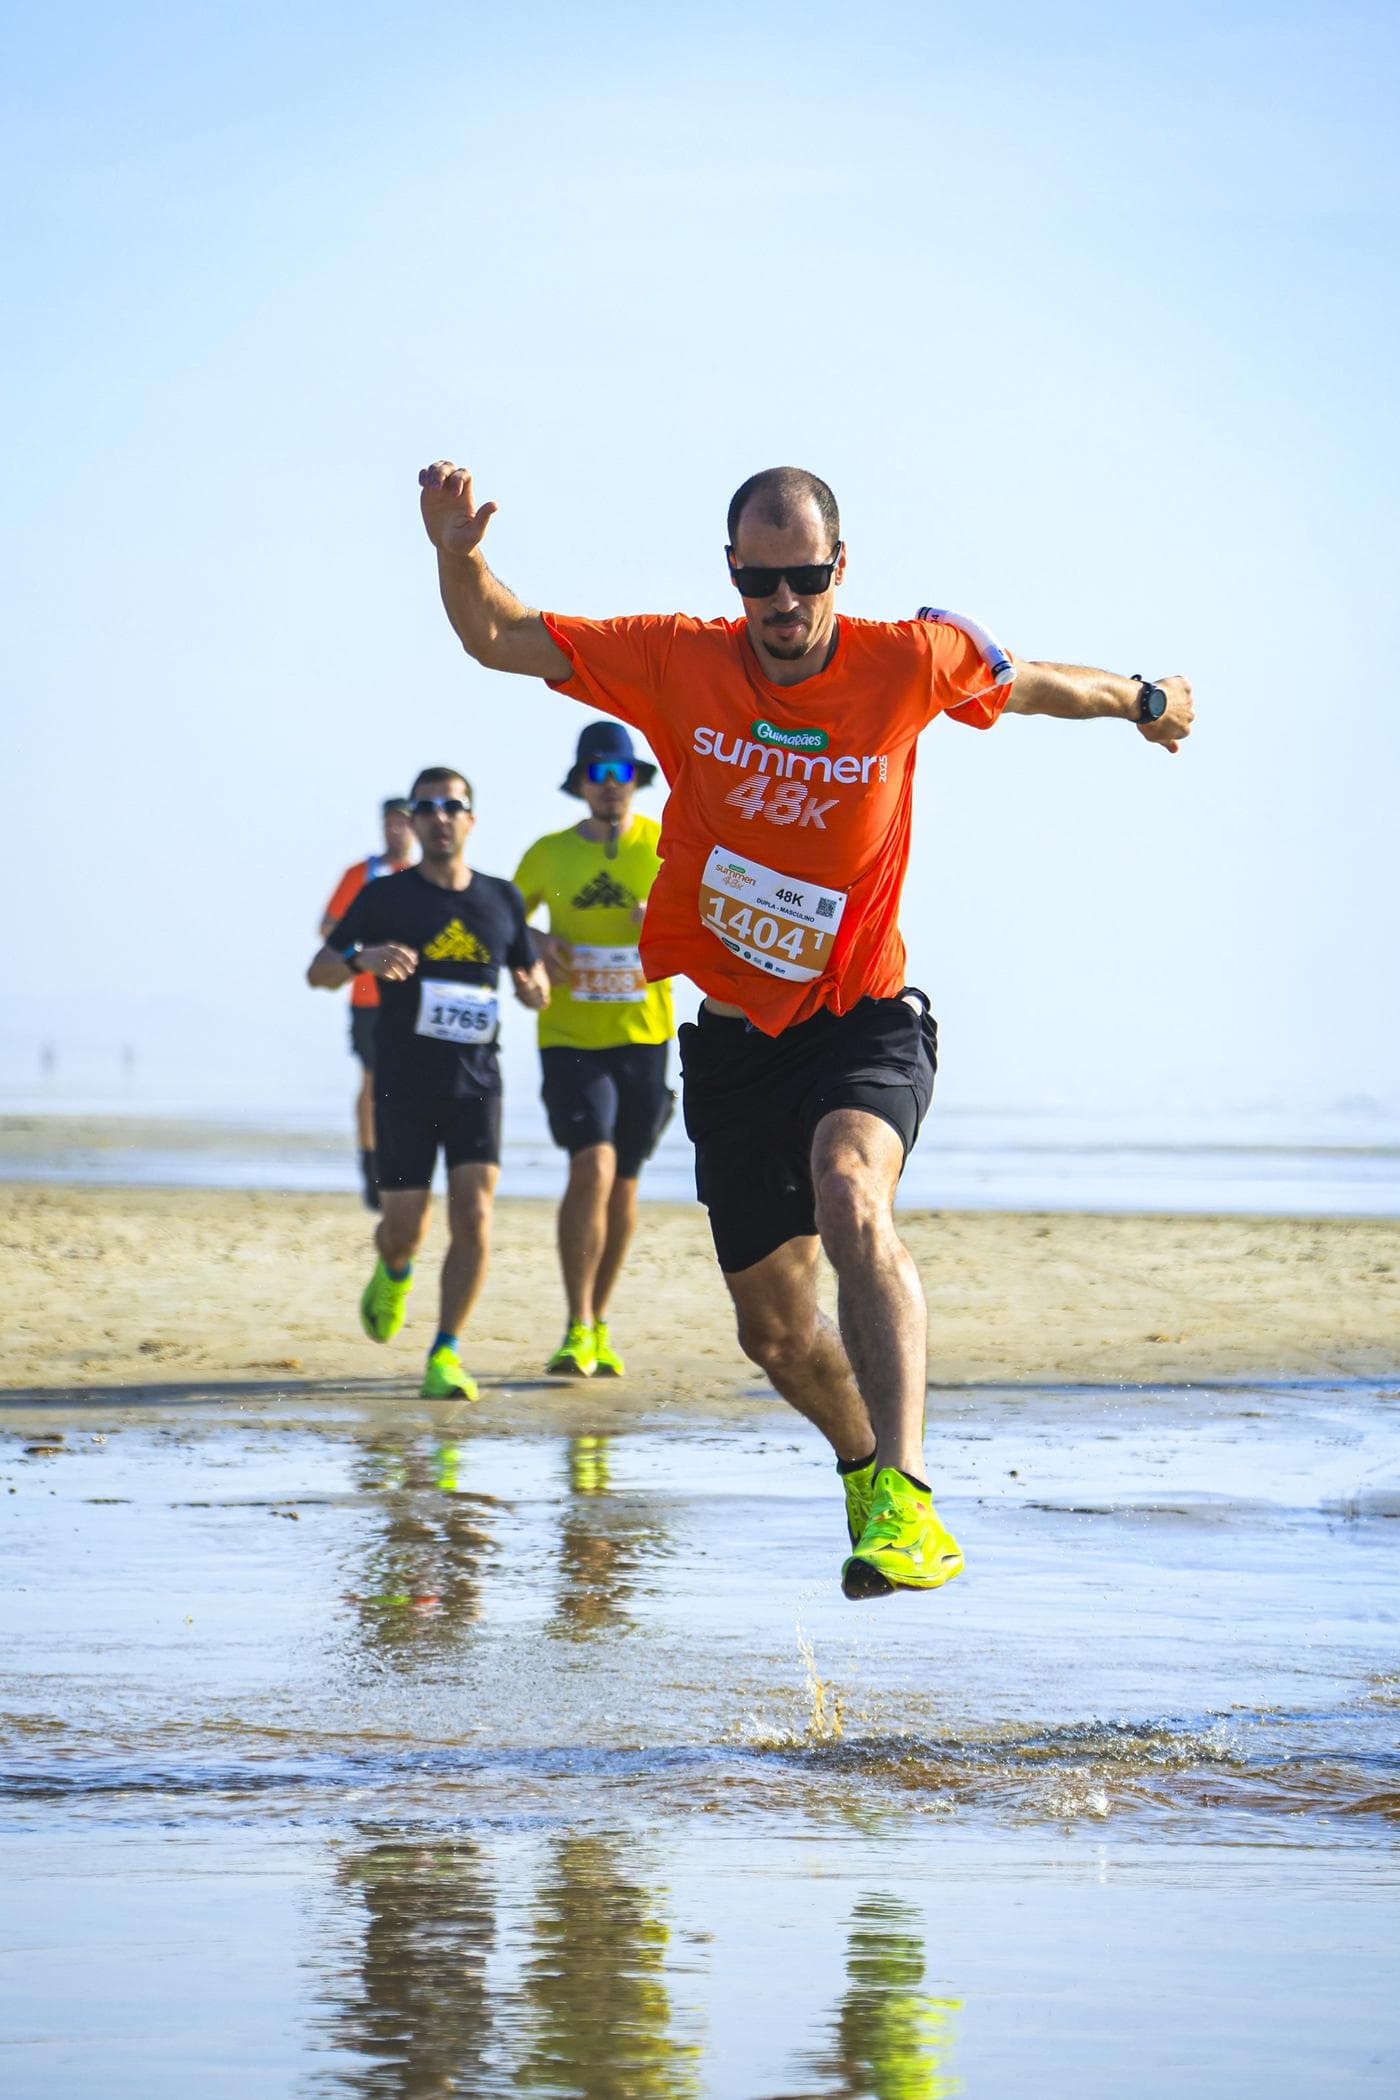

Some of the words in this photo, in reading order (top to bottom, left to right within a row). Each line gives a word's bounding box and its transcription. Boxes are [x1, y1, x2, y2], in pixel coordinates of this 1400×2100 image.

[693, 727, 877, 784] summer
[878, 754, 888, 784] 2025
[724, 773, 840, 829] 48K
[756, 897, 776, 910] DUPLA
[779, 906, 815, 923] MASCULINO
[775, 888, 804, 907] 48K
[706, 896, 805, 960] 1404
[814, 932, 825, 950] 1
